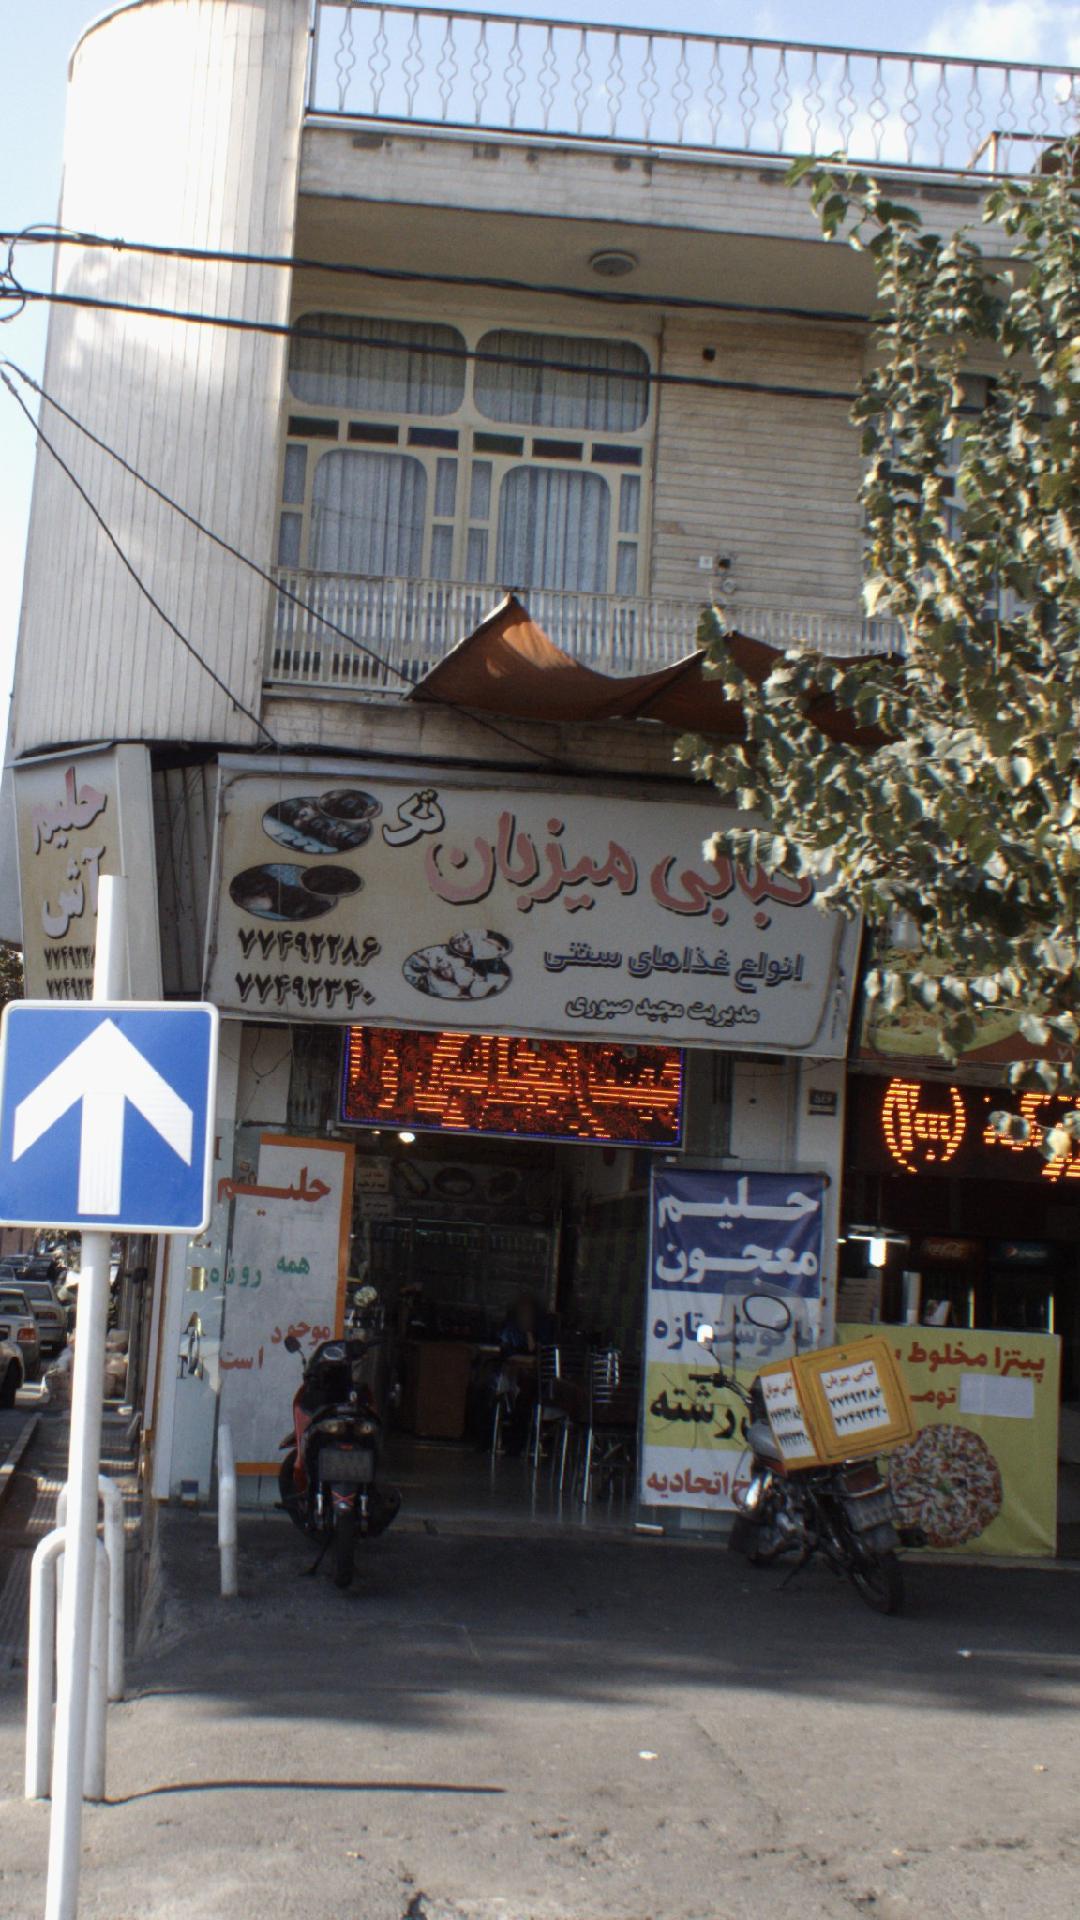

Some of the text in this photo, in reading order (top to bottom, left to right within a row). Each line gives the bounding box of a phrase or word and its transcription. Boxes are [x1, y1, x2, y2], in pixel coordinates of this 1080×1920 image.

[31, 766, 108, 856] حلیم
[424, 809, 638, 914] میزبان
[543, 941, 805, 993] انواع غذاهای سنتی
[234, 971, 377, 1011] ۷۷۴۹۲۳۴۰
[564, 995, 761, 1027] مدیریت مجید صبوری
[217, 1165, 332, 1217] حلیم
[657, 1176, 820, 1230] حلیم
[276, 1255, 311, 1276] همه
[655, 1242, 819, 1284] معجون
[906, 1341, 1046, 1384] پیتزا مخلوط
[645, 1466, 729, 1499] اتحادیه
